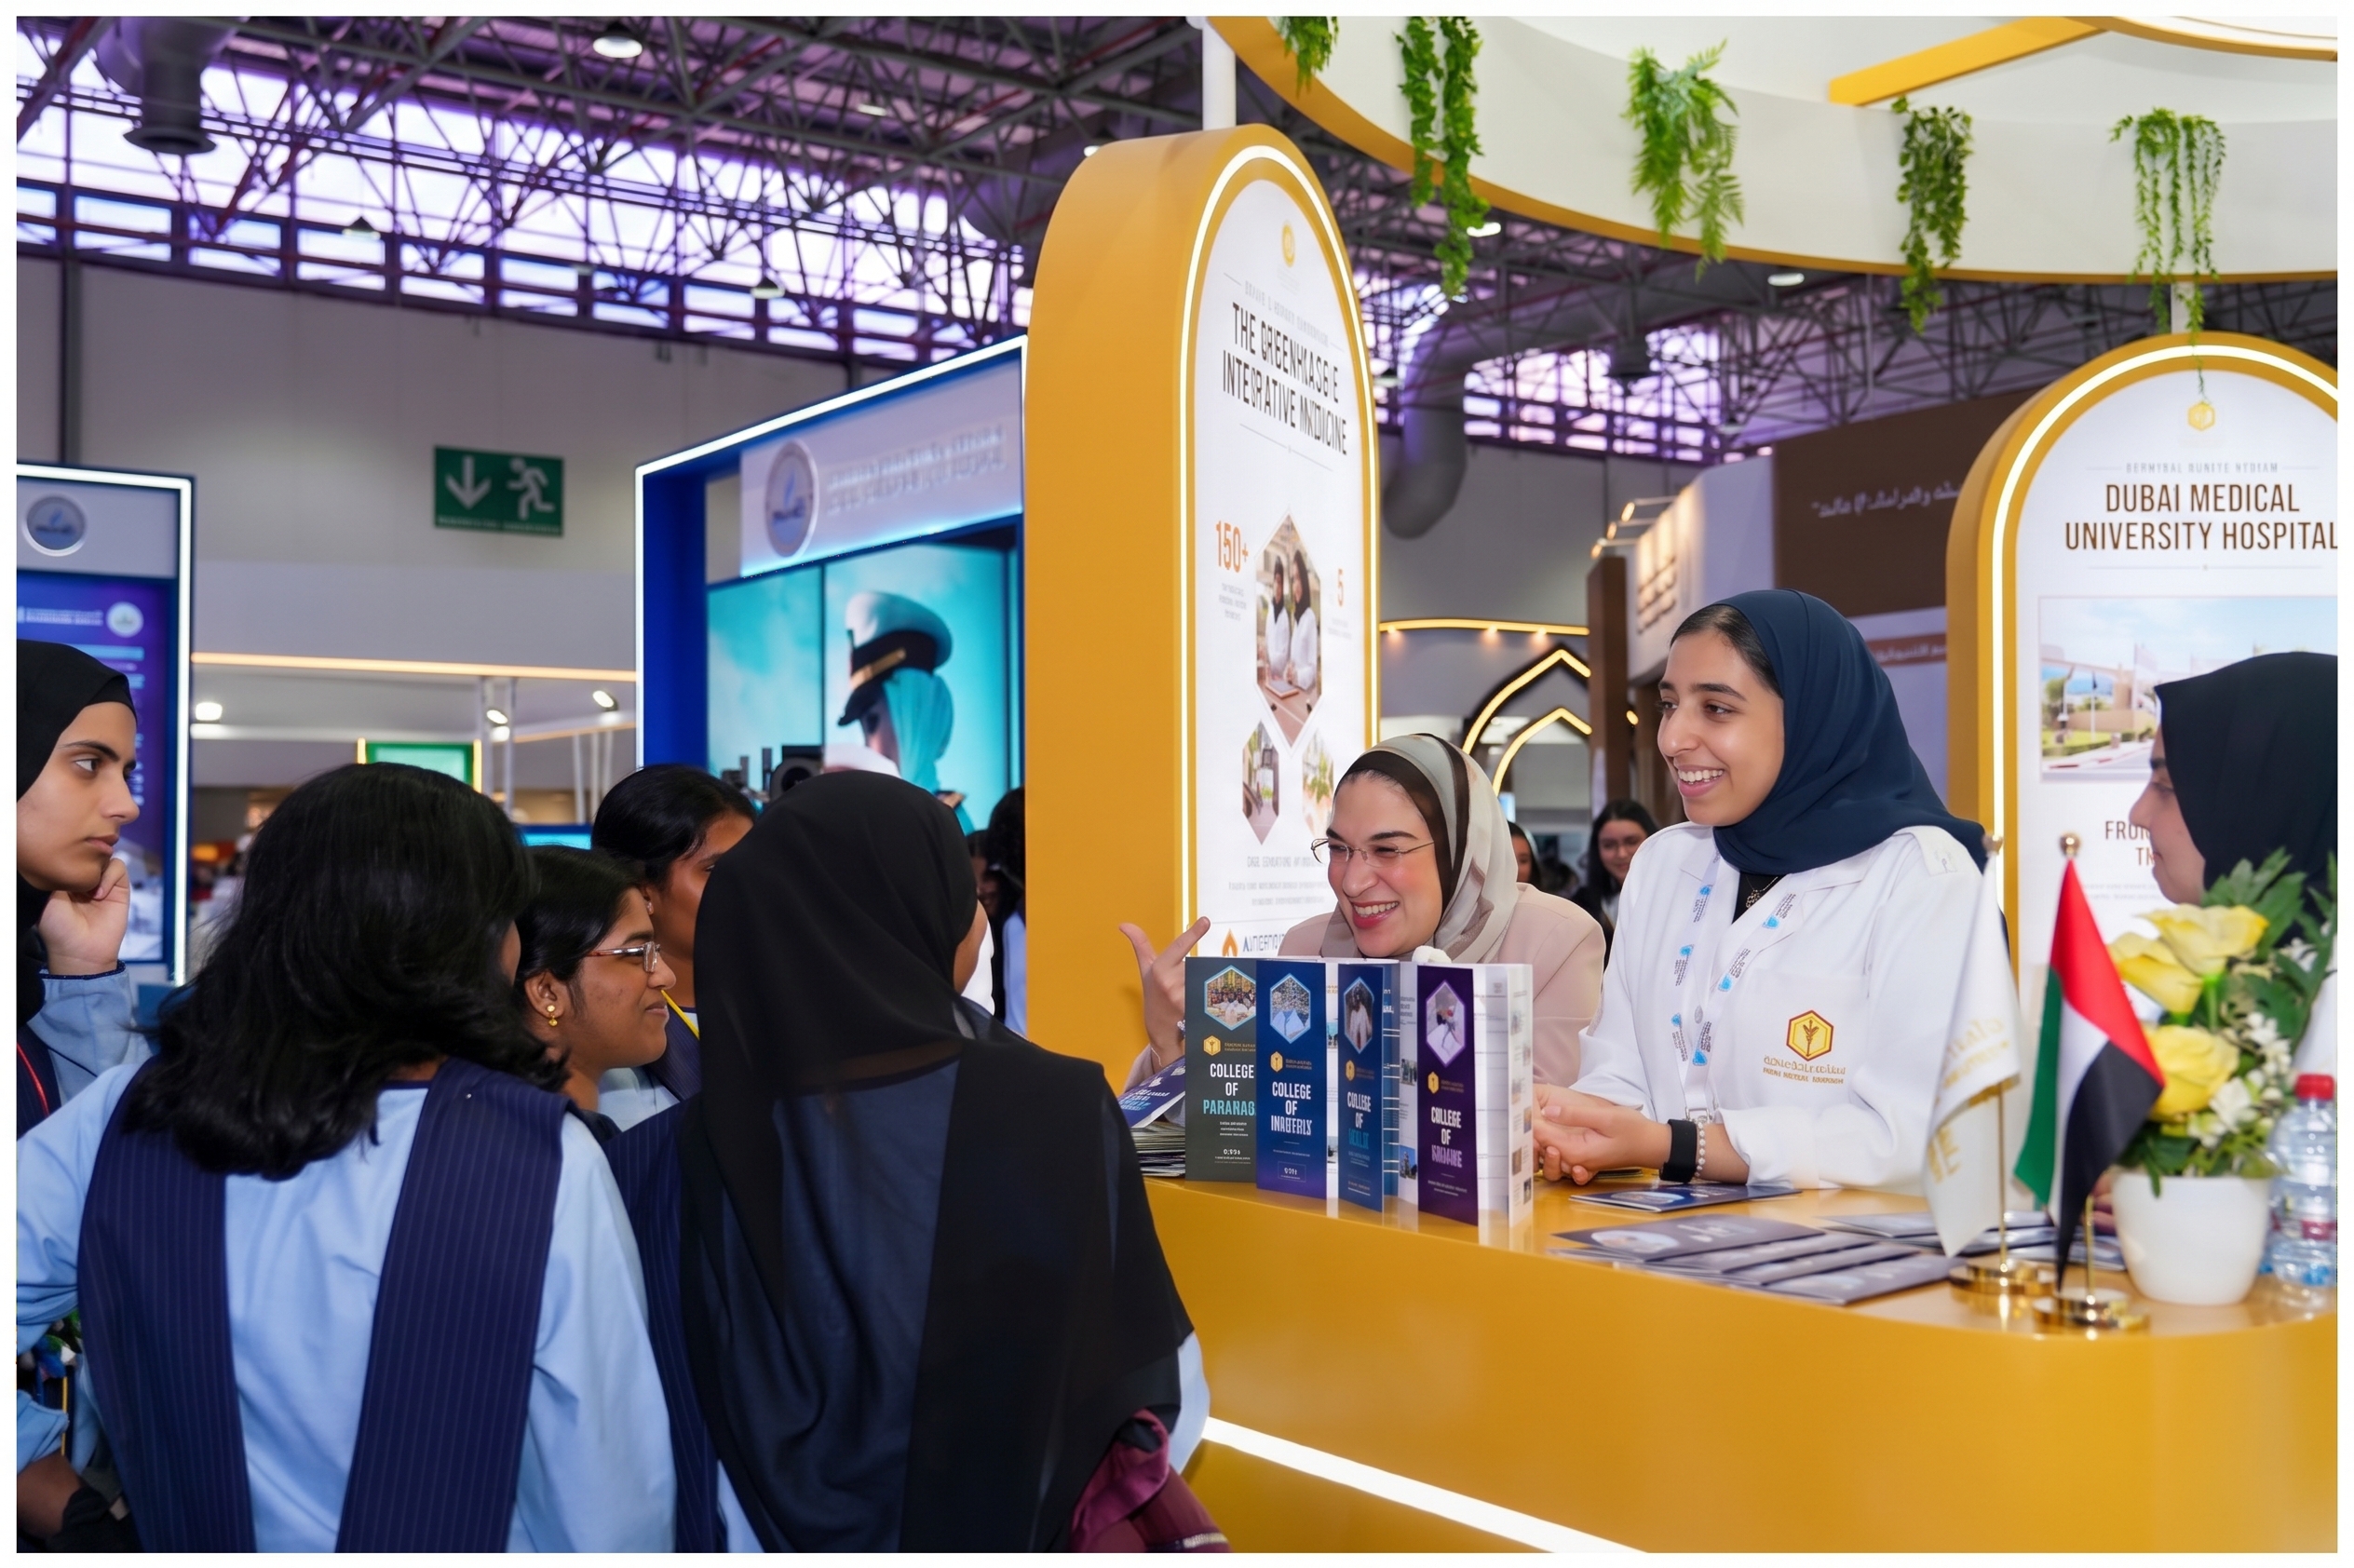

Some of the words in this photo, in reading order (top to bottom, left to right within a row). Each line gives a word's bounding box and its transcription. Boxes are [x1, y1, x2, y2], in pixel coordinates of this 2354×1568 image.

[1233, 302, 1255, 355] THE
[2106, 484, 2180, 512] DUBAI
[2191, 484, 2300, 512] MEDICAL
[2065, 522, 2212, 549] UNIVERSITY
[2223, 522, 2338, 549] HOSPITAL
[1216, 520, 1249, 573] 150+
[1210, 1062, 1254, 1078] COLLEGE
[1225, 1082, 1238, 1096] OF
[1272, 1081, 1311, 1100] COLLEGE
[1285, 1100, 1298, 1115] OF
[1355, 1112, 1363, 1129] OF
[1441, 1129, 1452, 1145] OF
